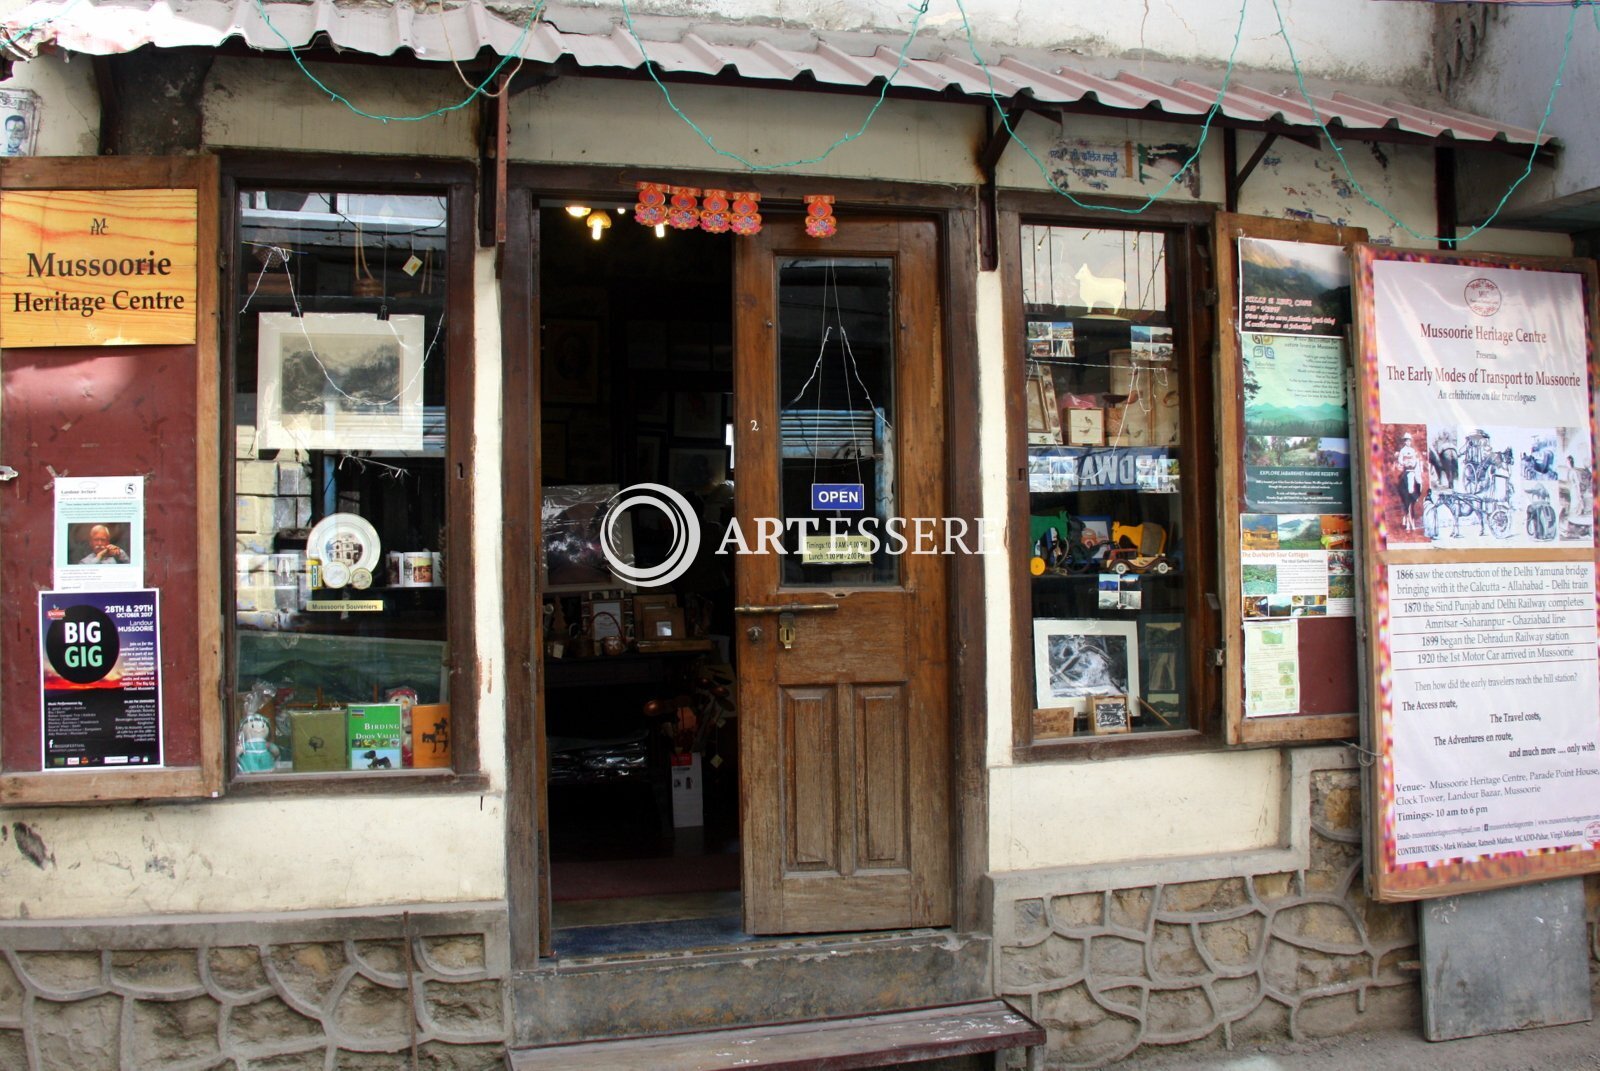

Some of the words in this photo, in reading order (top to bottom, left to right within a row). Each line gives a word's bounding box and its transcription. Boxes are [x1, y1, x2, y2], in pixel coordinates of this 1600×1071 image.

[27, 250, 171, 278] Mussoorie
[13, 291, 105, 317] Heritage
[112, 290, 184, 310] Centre
[1421, 323, 1472, 339] Mussoorie
[1476, 325, 1513, 345] Heritage
[1516, 328, 1546, 343] Centre
[1387, 366, 1404, 380] The
[1408, 366, 1432, 386] Early
[1435, 368, 1466, 382] Modes
[1469, 368, 1478, 382] of
[1480, 369, 1522, 388] Transport
[1525, 372, 1533, 385] to
[1536, 372, 1580, 387] Mussoorie
[1438, 390, 1447, 399] An
[1449, 390, 1480, 400] exhibition
[1491, 391, 1501, 400] the
[1502, 392, 1536, 404] travelogues
[750, 420, 759, 432] 2
[819, 491, 858, 502] OPEN
[1397, 570, 1413, 579] 1866
[1432, 569, 1443, 578] the
[1445, 568, 1490, 578] construction
[1501, 567, 1512, 576] the
[1514, 566, 1533, 576] Delhi
[1535, 566, 1563, 576] Yamuna
[1566, 565, 1588, 578] bridge
[1397, 584, 1429, 597] bringing
[1431, 583, 1447, 593] with
[1457, 582, 1468, 592] the
[1470, 582, 1500, 592] Calcutta
[1508, 580, 1543, 590] Allahabad
[1552, 579, 1570, 589] Delhi
[1572, 579, 1588, 589] train
[1404, 602, 1421, 613] 1870
[1423, 602, 1434, 612] the
[1436, 601, 1452, 611] Sind
[1455, 601, 1480, 612] Punjab
[1481, 600, 1495, 609] and
[1497, 599, 1516, 608] Delhi
[1518, 598, 1546, 611] Railway
[1548, 597, 1584, 609] completes
[1425, 619, 1458, 629] Amritsar
[1512, 614, 1550, 625] Ghaziabad
[1552, 614, 1566, 623] line
[64, 621, 101, 643] BIG
[1422, 636, 1438, 646] 1899
[1440, 635, 1462, 648] began
[1464, 634, 1475, 644] the
[1477, 633, 1513, 643] Dehradun
[1515, 632, 1544, 644] Railway
[1546, 631, 1569, 640] station
[64, 646, 103, 667] GIG
[1417, 653, 1435, 664] 1920
[1437, 653, 1448, 662] the
[1450, 652, 1460, 662] 1st
[1462, 651, 1485, 661] Motor
[1486, 650, 1500, 660] Car
[1501, 648, 1526, 659] arrived
[1537, 646, 1574, 658] Mussoorie
[1415, 681, 1431, 691] Then
[1433, 680, 1446, 690] how
[1448, 679, 1458, 689] did
[1460, 679, 1470, 688] the
[1471, 677, 1486, 689] early
[1488, 676, 1514, 687] travelers
[1516, 675, 1532, 684] reach
[1533, 674, 1542, 683] the
[1543, 673, 1553, 683] hill
[1555, 672, 1577, 682] station?
[1402, 701, 1415, 711] The
[1416, 701, 1437, 710] Access
[1440, 700, 1458, 709] route,
[1490, 714, 1502, 723] The
[1503, 712, 1524, 722] Travel
[1525, 712, 1541, 721] costs,
[1434, 736, 1446, 746] The
[1448, 735, 1484, 745] Adventures
[1495, 732, 1513, 741] route,
[1509, 748, 1520, 758] and
[1522, 746, 1539, 756] much
[1541, 747, 1556, 755] more
[1567, 743, 1580, 755] only
[1582, 742, 1595, 751] with
[1396, 784, 1426, 792] Venue:-
[1429, 781, 1468, 789] Mussoorie
[1470, 776, 1501, 786] Heritage
[1502, 774, 1528, 783] Centre,
[1530, 770, 1554, 780] Parade
[1556, 769, 1574, 778] Point
[1576, 768, 1599, 777] House,
[1396, 796, 1418, 805] Clock
[1419, 795, 1445, 804] Tower,
[1448, 791, 1478, 800] Landour
[1481, 788, 1502, 798] Bazar,
[1504, 786, 1541, 795] Mussoorie
[1397, 811, 1434, 821] Timings:-
[1446, 808, 1459, 816] am
[1476, 806, 1488, 816] pm
